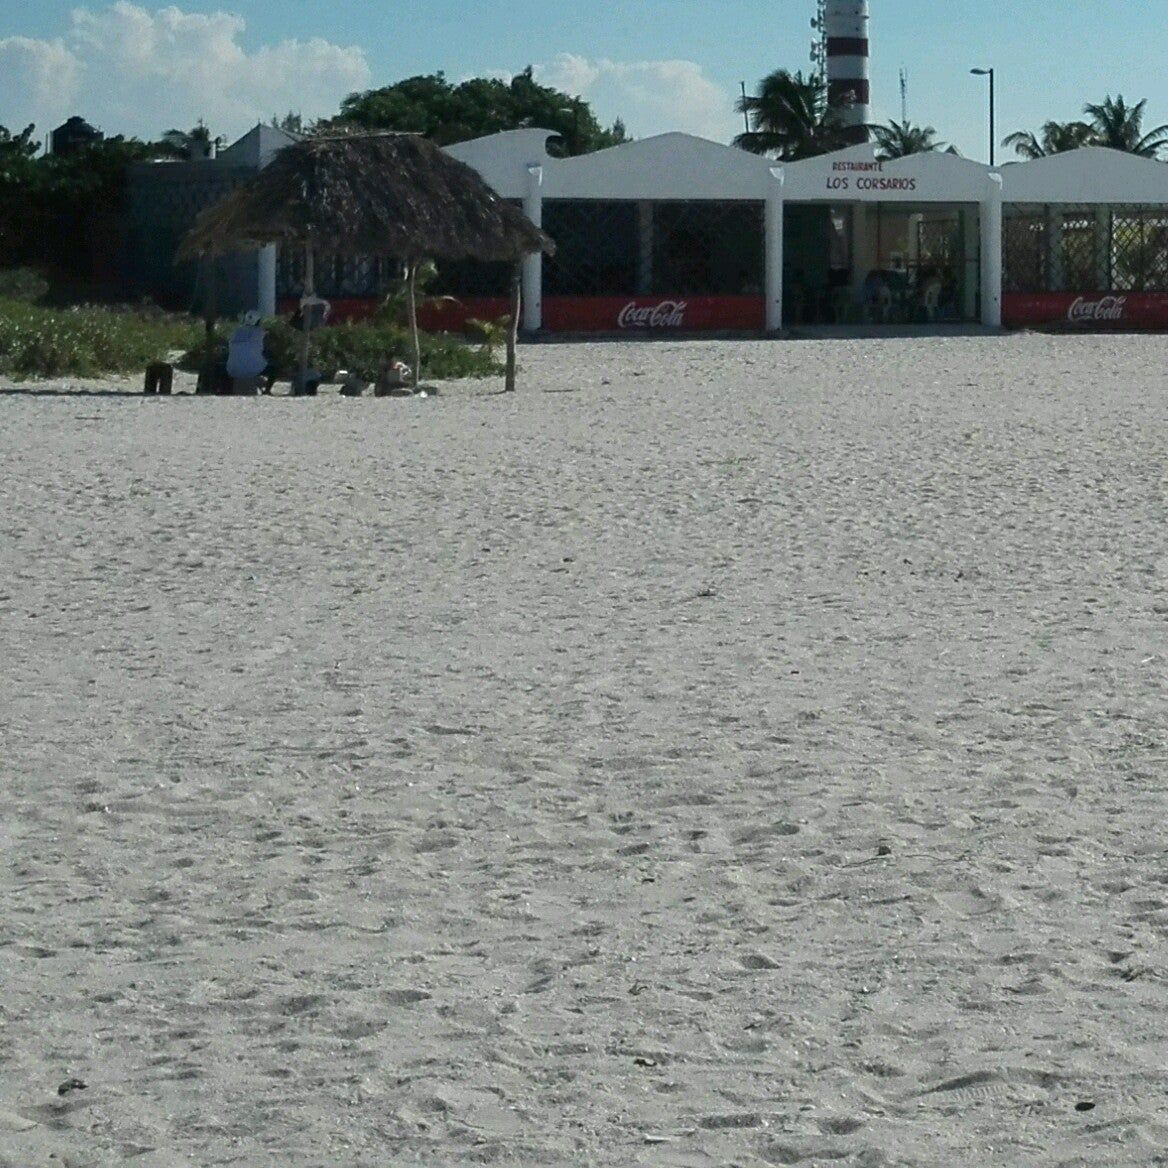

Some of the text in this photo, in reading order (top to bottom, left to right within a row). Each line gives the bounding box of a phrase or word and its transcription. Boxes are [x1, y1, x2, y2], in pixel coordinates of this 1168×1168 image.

[833, 162, 883, 172] RESTAURANTE
[826, 177, 916, 191] LOS CORSARIOS
